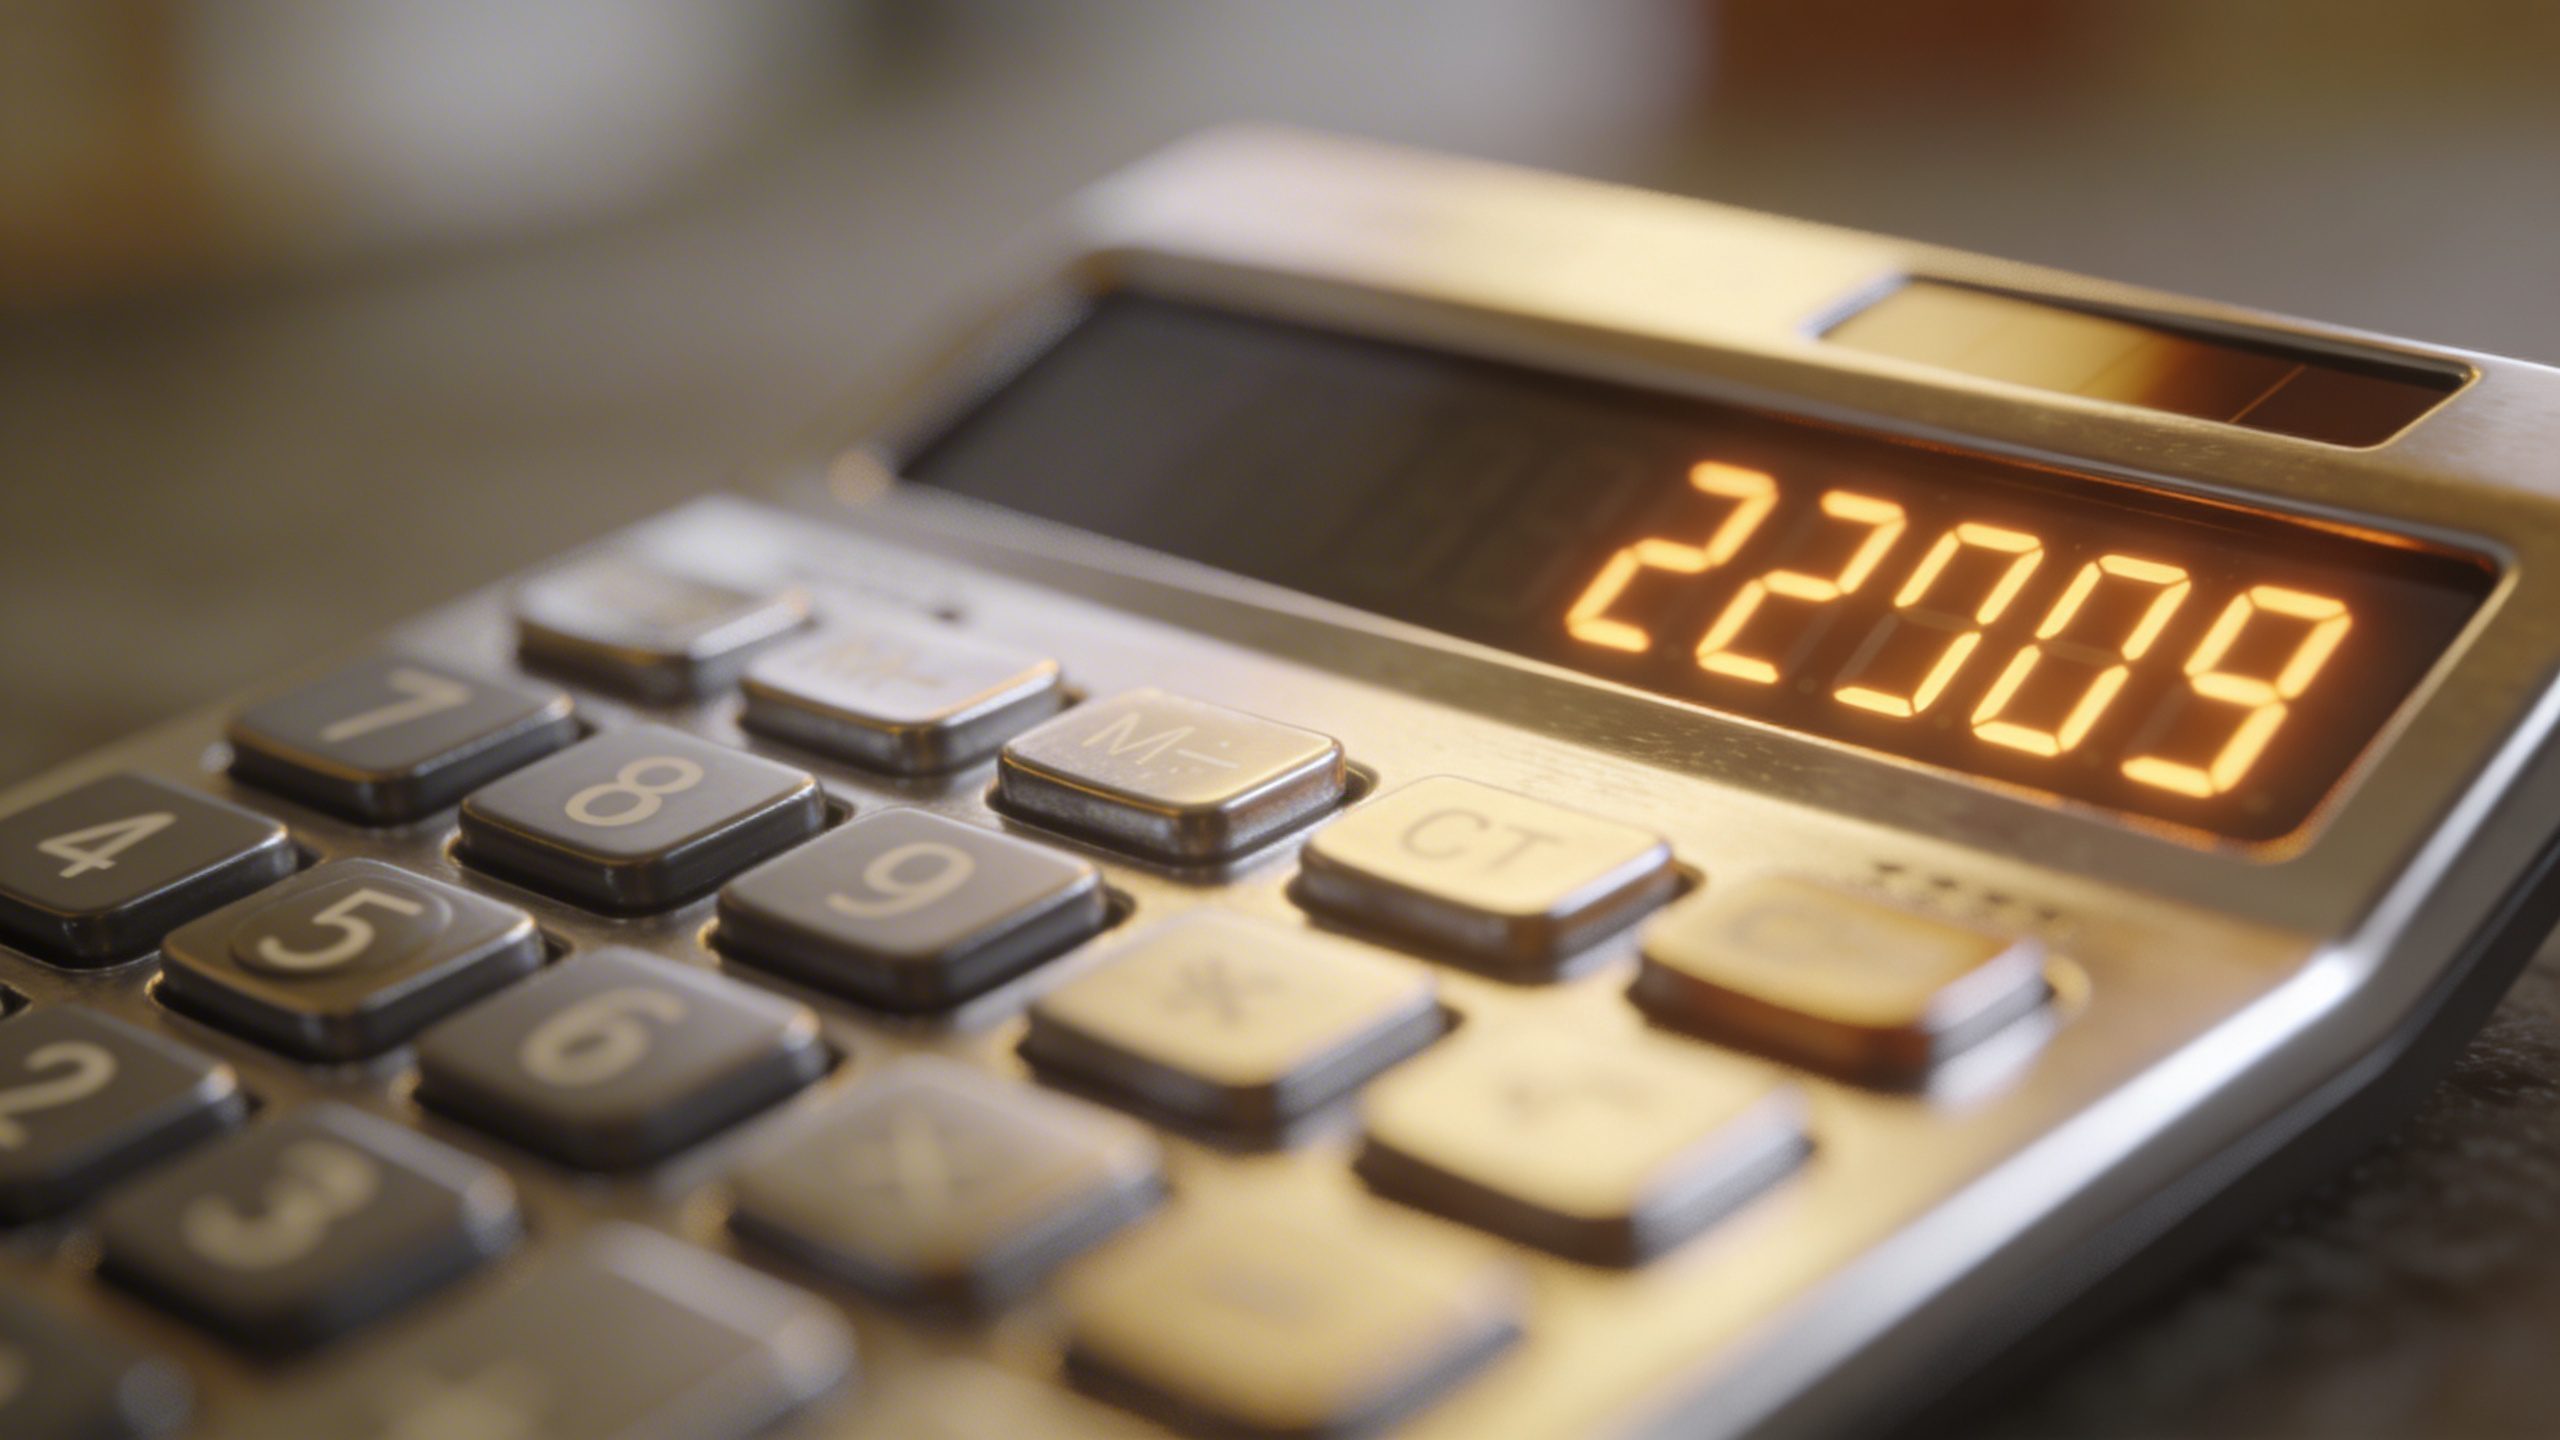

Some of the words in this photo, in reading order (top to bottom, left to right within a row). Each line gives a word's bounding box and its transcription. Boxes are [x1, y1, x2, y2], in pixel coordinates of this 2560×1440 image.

[320, 667, 472, 743] 7
[565, 756, 703, 826] 8
[38, 812, 176, 878] 4
[1402, 806, 1565, 875] CT
[827, 842, 975, 917] 9
[258, 888, 422, 971] 5
[520, 986, 688, 1088] 6
[0, 1040, 117, 1149] 2
[182, 1138, 380, 1271] 3
